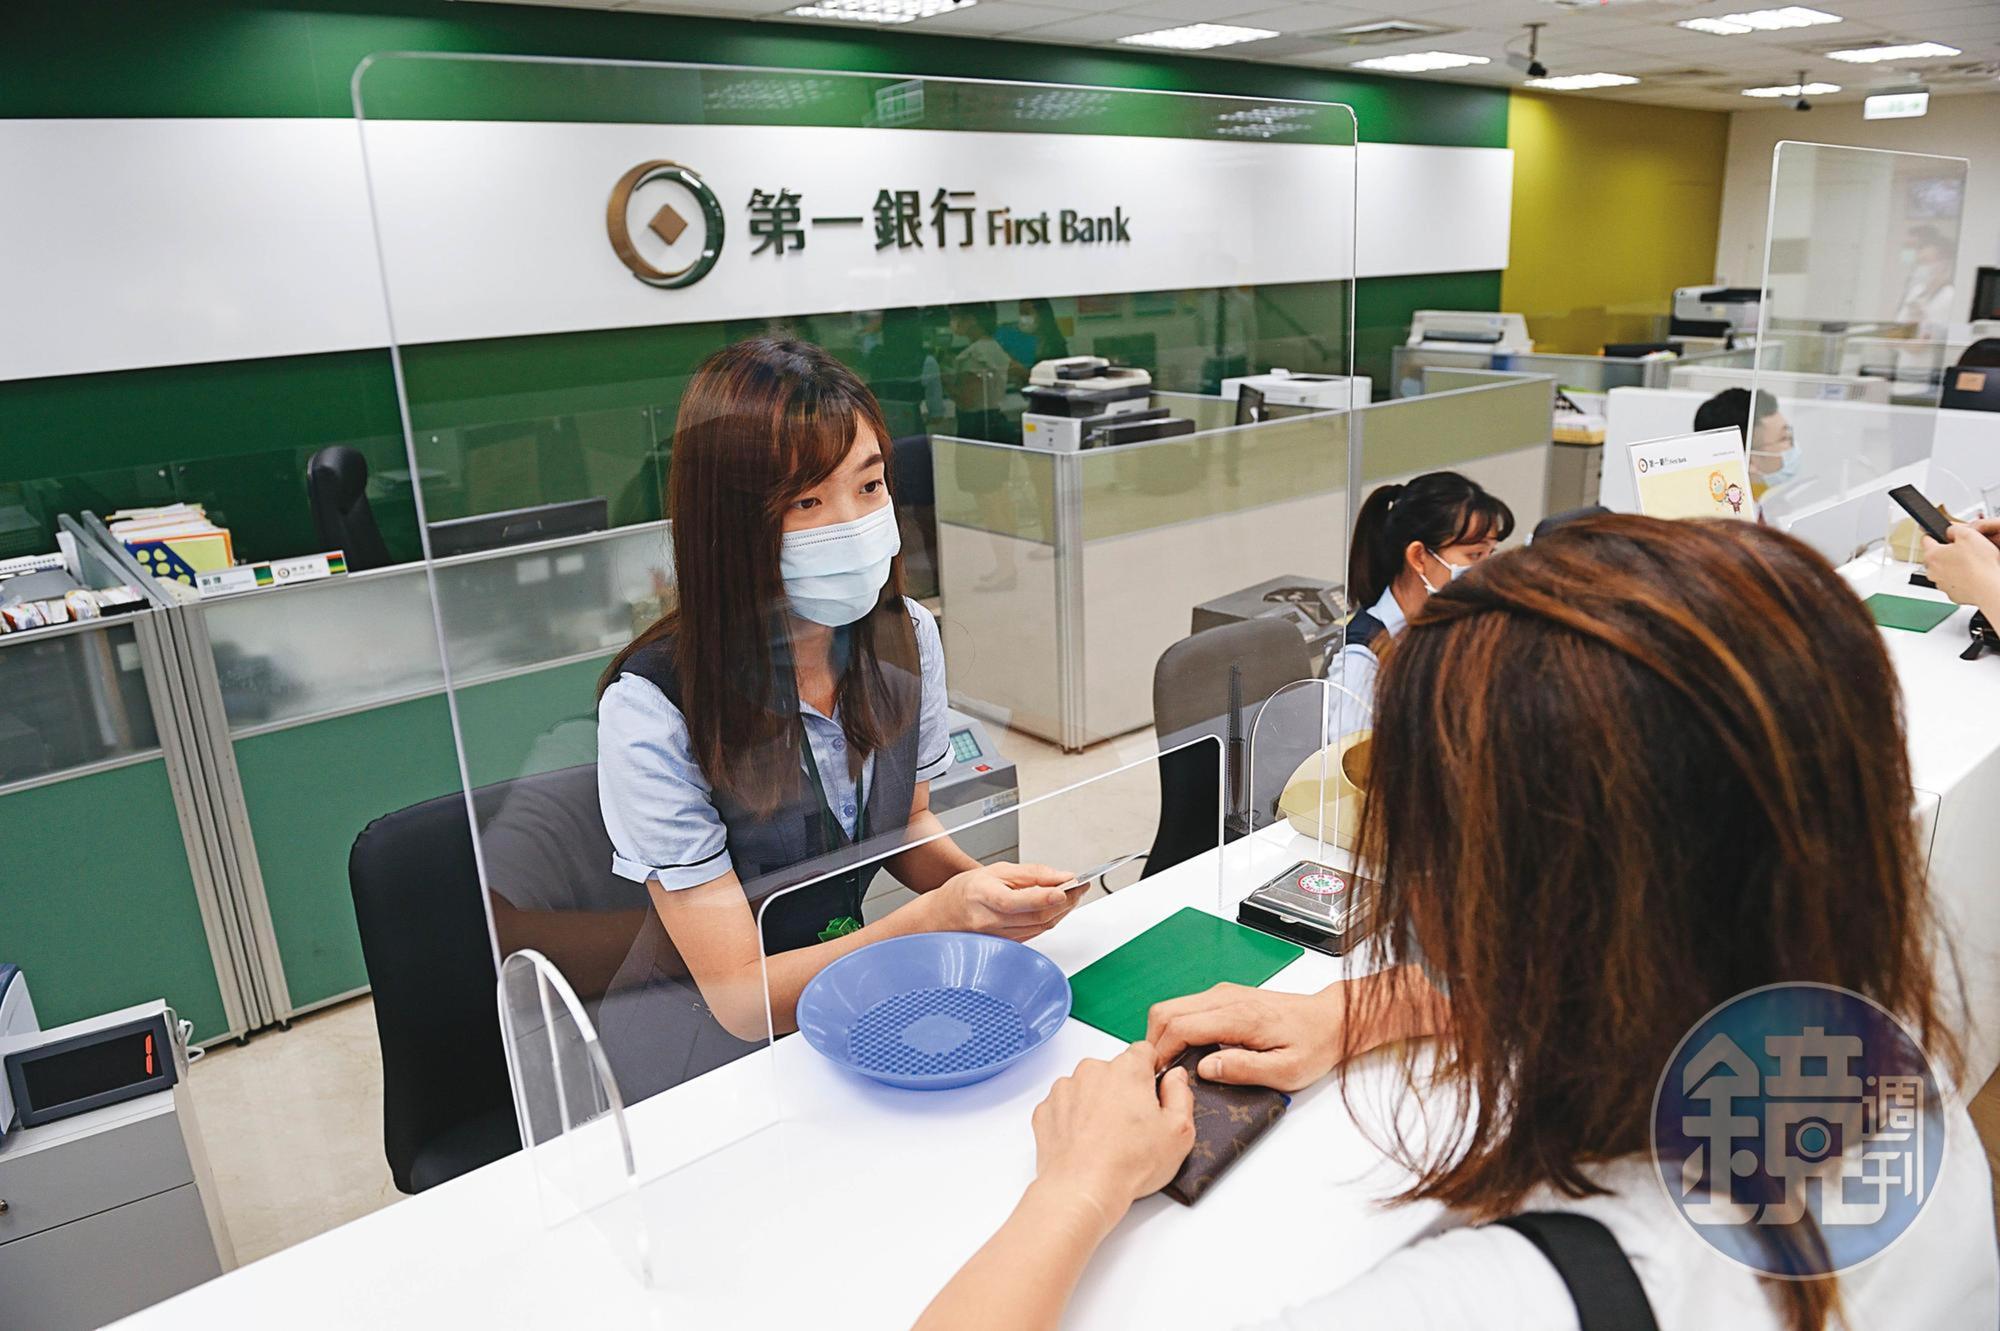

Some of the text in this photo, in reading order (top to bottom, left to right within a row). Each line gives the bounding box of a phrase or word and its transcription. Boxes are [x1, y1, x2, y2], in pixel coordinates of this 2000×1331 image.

[746, 186, 1132, 256] 第一銀行 First Bank
